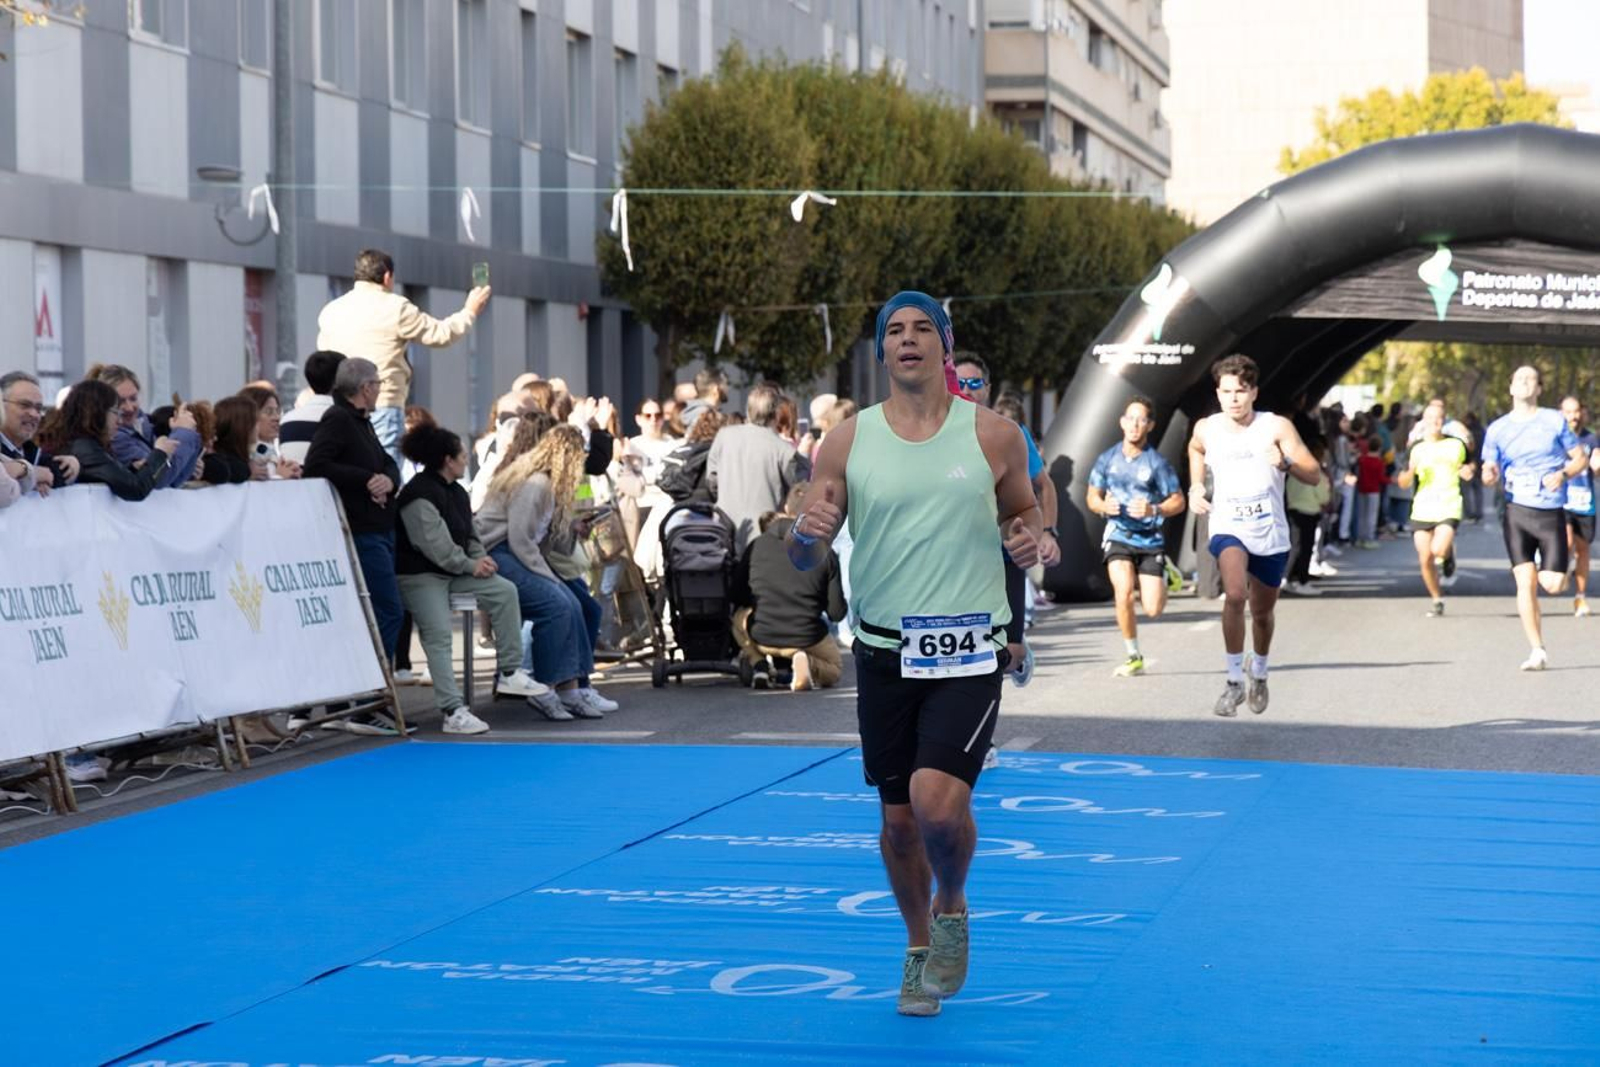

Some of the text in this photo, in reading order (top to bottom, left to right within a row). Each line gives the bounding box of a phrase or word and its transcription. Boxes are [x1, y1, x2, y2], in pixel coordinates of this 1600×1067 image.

[1463, 271, 1543, 289] Patronato
[1462, 289, 1538, 309] Deportes
[1541, 291, 1564, 308] de
[1235, 502, 1264, 517] 534
[167, 570, 216, 603] RURAL
[297, 559, 347, 589] RURAL
[29, 583, 84, 619] RURAL
[295, 591, 333, 628] JAÉN
[168, 604, 199, 641] AÉN
[28, 621, 68, 664] JAÉN
[918, 631, 977, 657] 694
[441, 971, 654, 984] MEDIA
